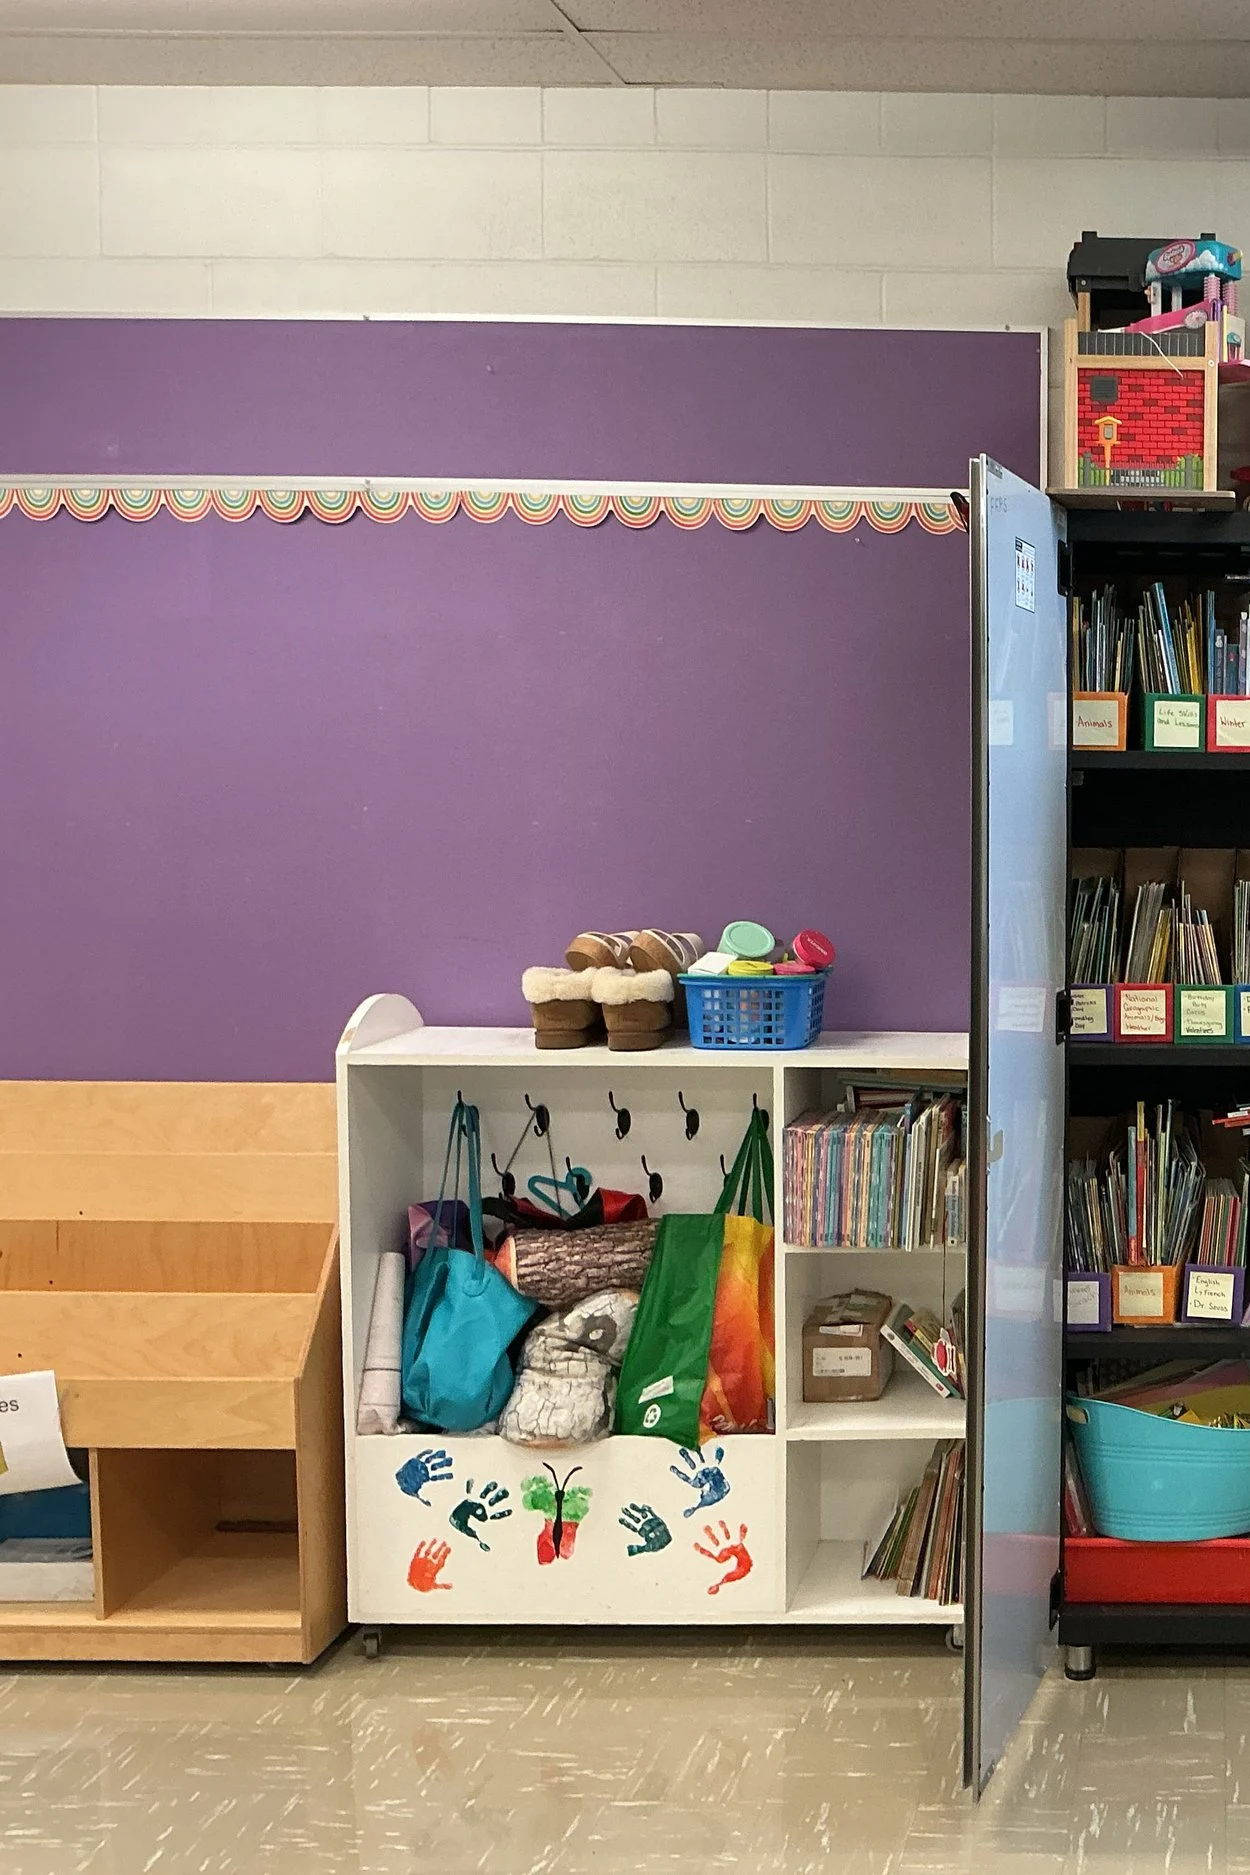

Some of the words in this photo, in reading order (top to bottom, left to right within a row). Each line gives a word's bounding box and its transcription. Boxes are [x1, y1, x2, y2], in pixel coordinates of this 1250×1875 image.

[1158, 708, 1174, 716] Life
[1076, 716, 1112, 729] Animals
[1156, 718, 1170, 726] and
[1220, 716, 1247, 729] Winter
[1126, 993, 1158, 1002] National
[1187, 994, 1214, 1002] Birthday
[1124, 1002, 1160, 1015] Geographic
[1126, 1022, 1151, 1031] Weather
[1196, 1276, 1220, 1288] English
[1124, 1285, 1156, 1297] Animals
[1204, 1290, 1226, 1298] French
[1208, 1302, 1228, 1312] Seuss
